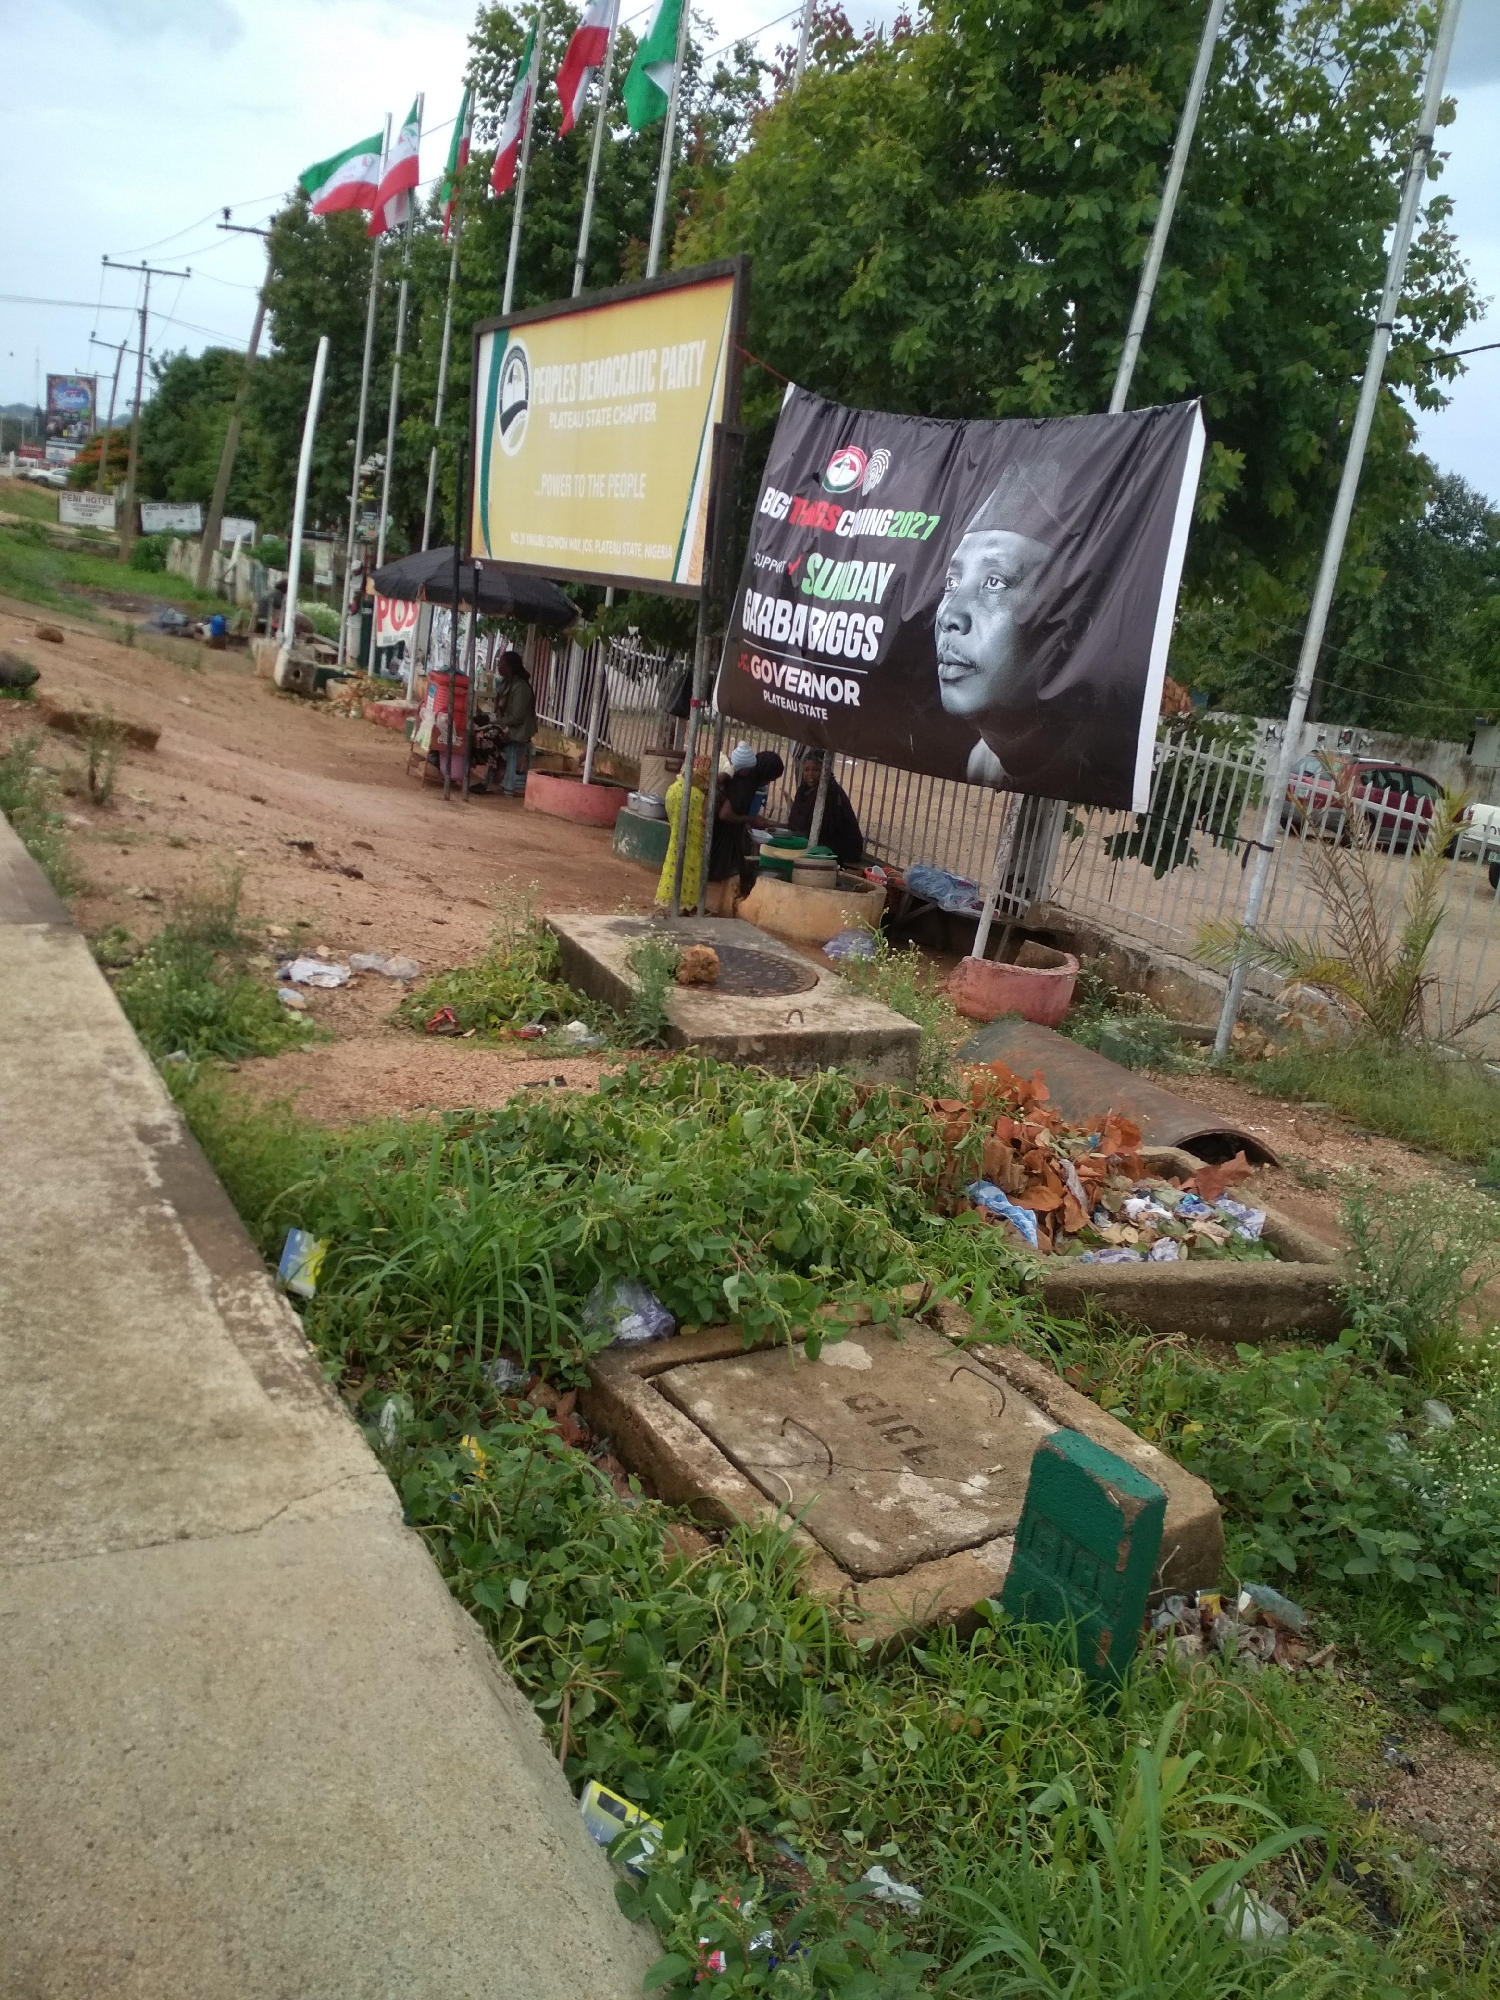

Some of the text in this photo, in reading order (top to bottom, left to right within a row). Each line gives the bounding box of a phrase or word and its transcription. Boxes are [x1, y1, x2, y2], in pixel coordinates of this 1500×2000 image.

[532, 363, 577, 405] PEOPLES
[579, 348, 657, 402] DEMOCRATIC
[659, 339, 707, 391] PARTY
[550, 402, 657, 429] PLATEAU STATE CHAPTER
[62, 493, 82, 503] FENI
[86, 495, 113, 506] HOTEL
[574, 473, 586, 498] TO
[588, 473, 605, 498] THE
[608, 472, 647, 499] PEOPLE
[595, 540, 622, 556] PLATEAU
[644, 543, 673, 560] NIGERIA
[742, 588, 809, 647] GARBA
[750, 656, 861, 707] GOVERNOR
[763, 690, 829, 720] PLATEAU STATE
